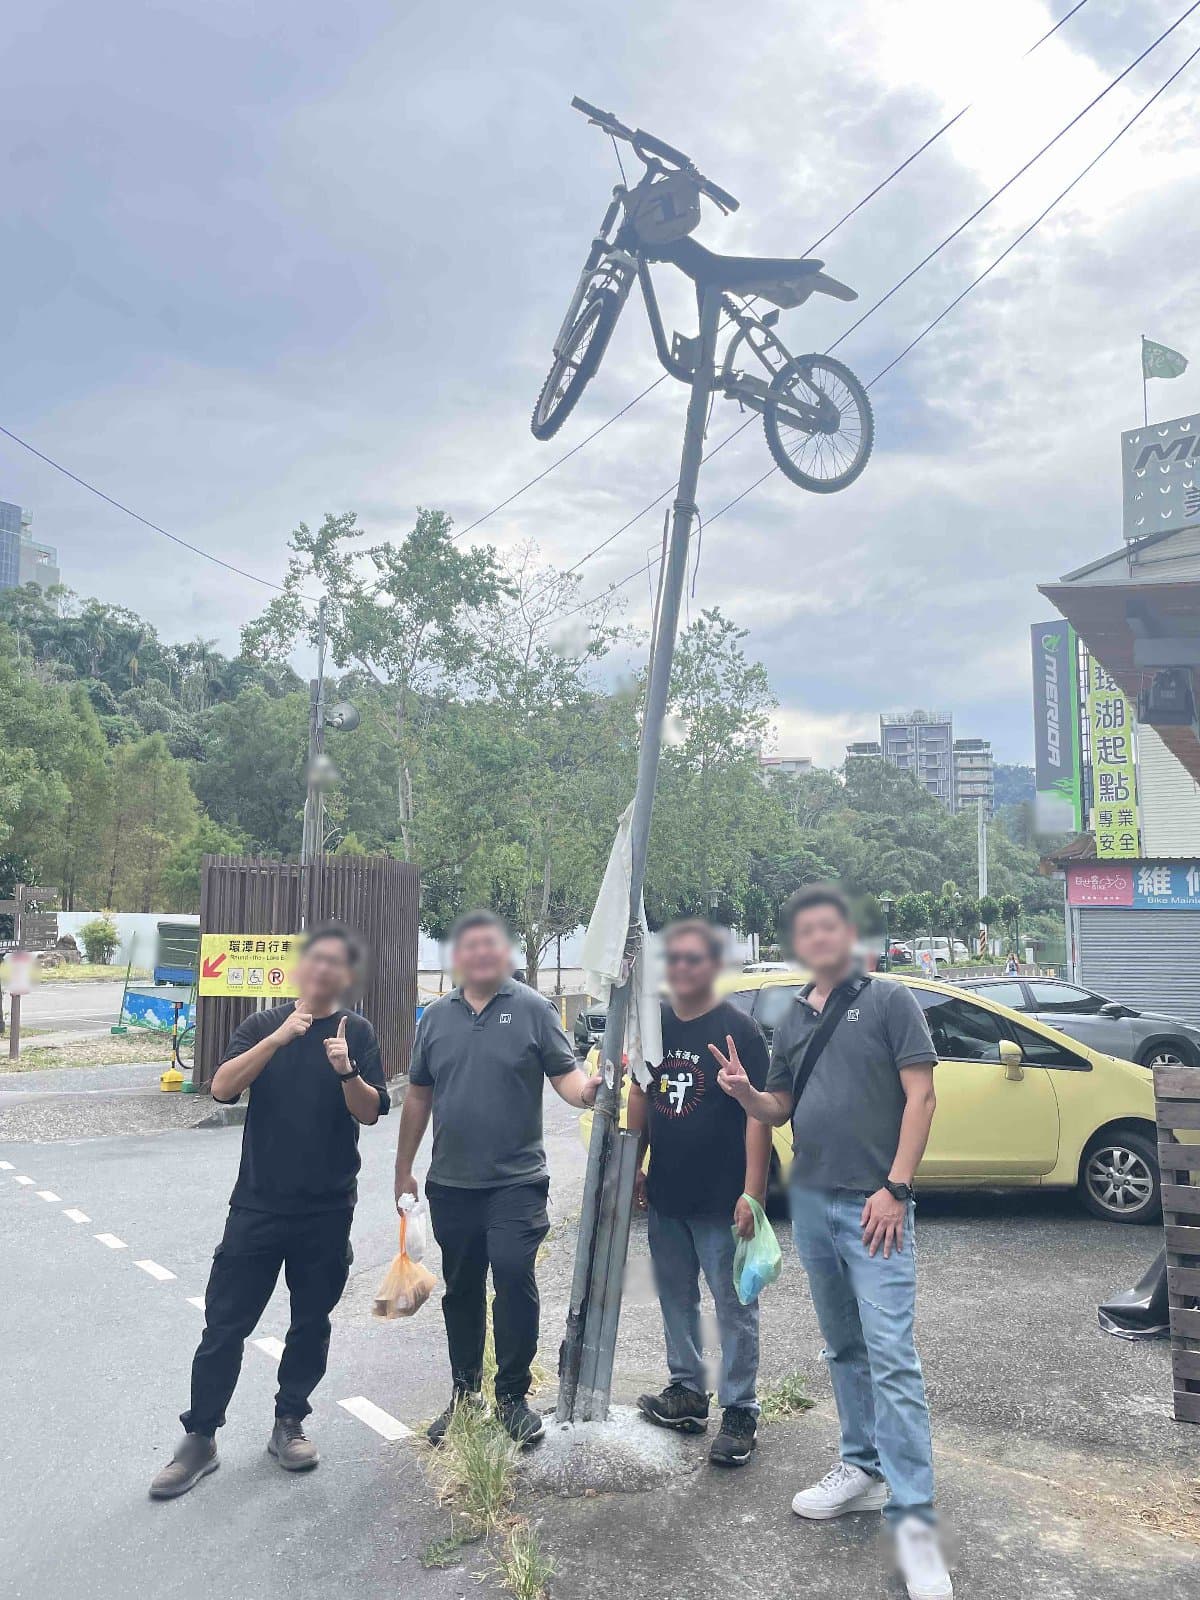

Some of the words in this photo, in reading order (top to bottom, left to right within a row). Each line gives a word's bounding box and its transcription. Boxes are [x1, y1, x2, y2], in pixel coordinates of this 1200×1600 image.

[1132, 435, 1200, 471] M
[1044, 654, 1061, 767] MERIDA
[1099, 809, 1133, 827] 專業
[1099, 833, 1135, 851] 安全
[1147, 896, 1169, 904] Bike
